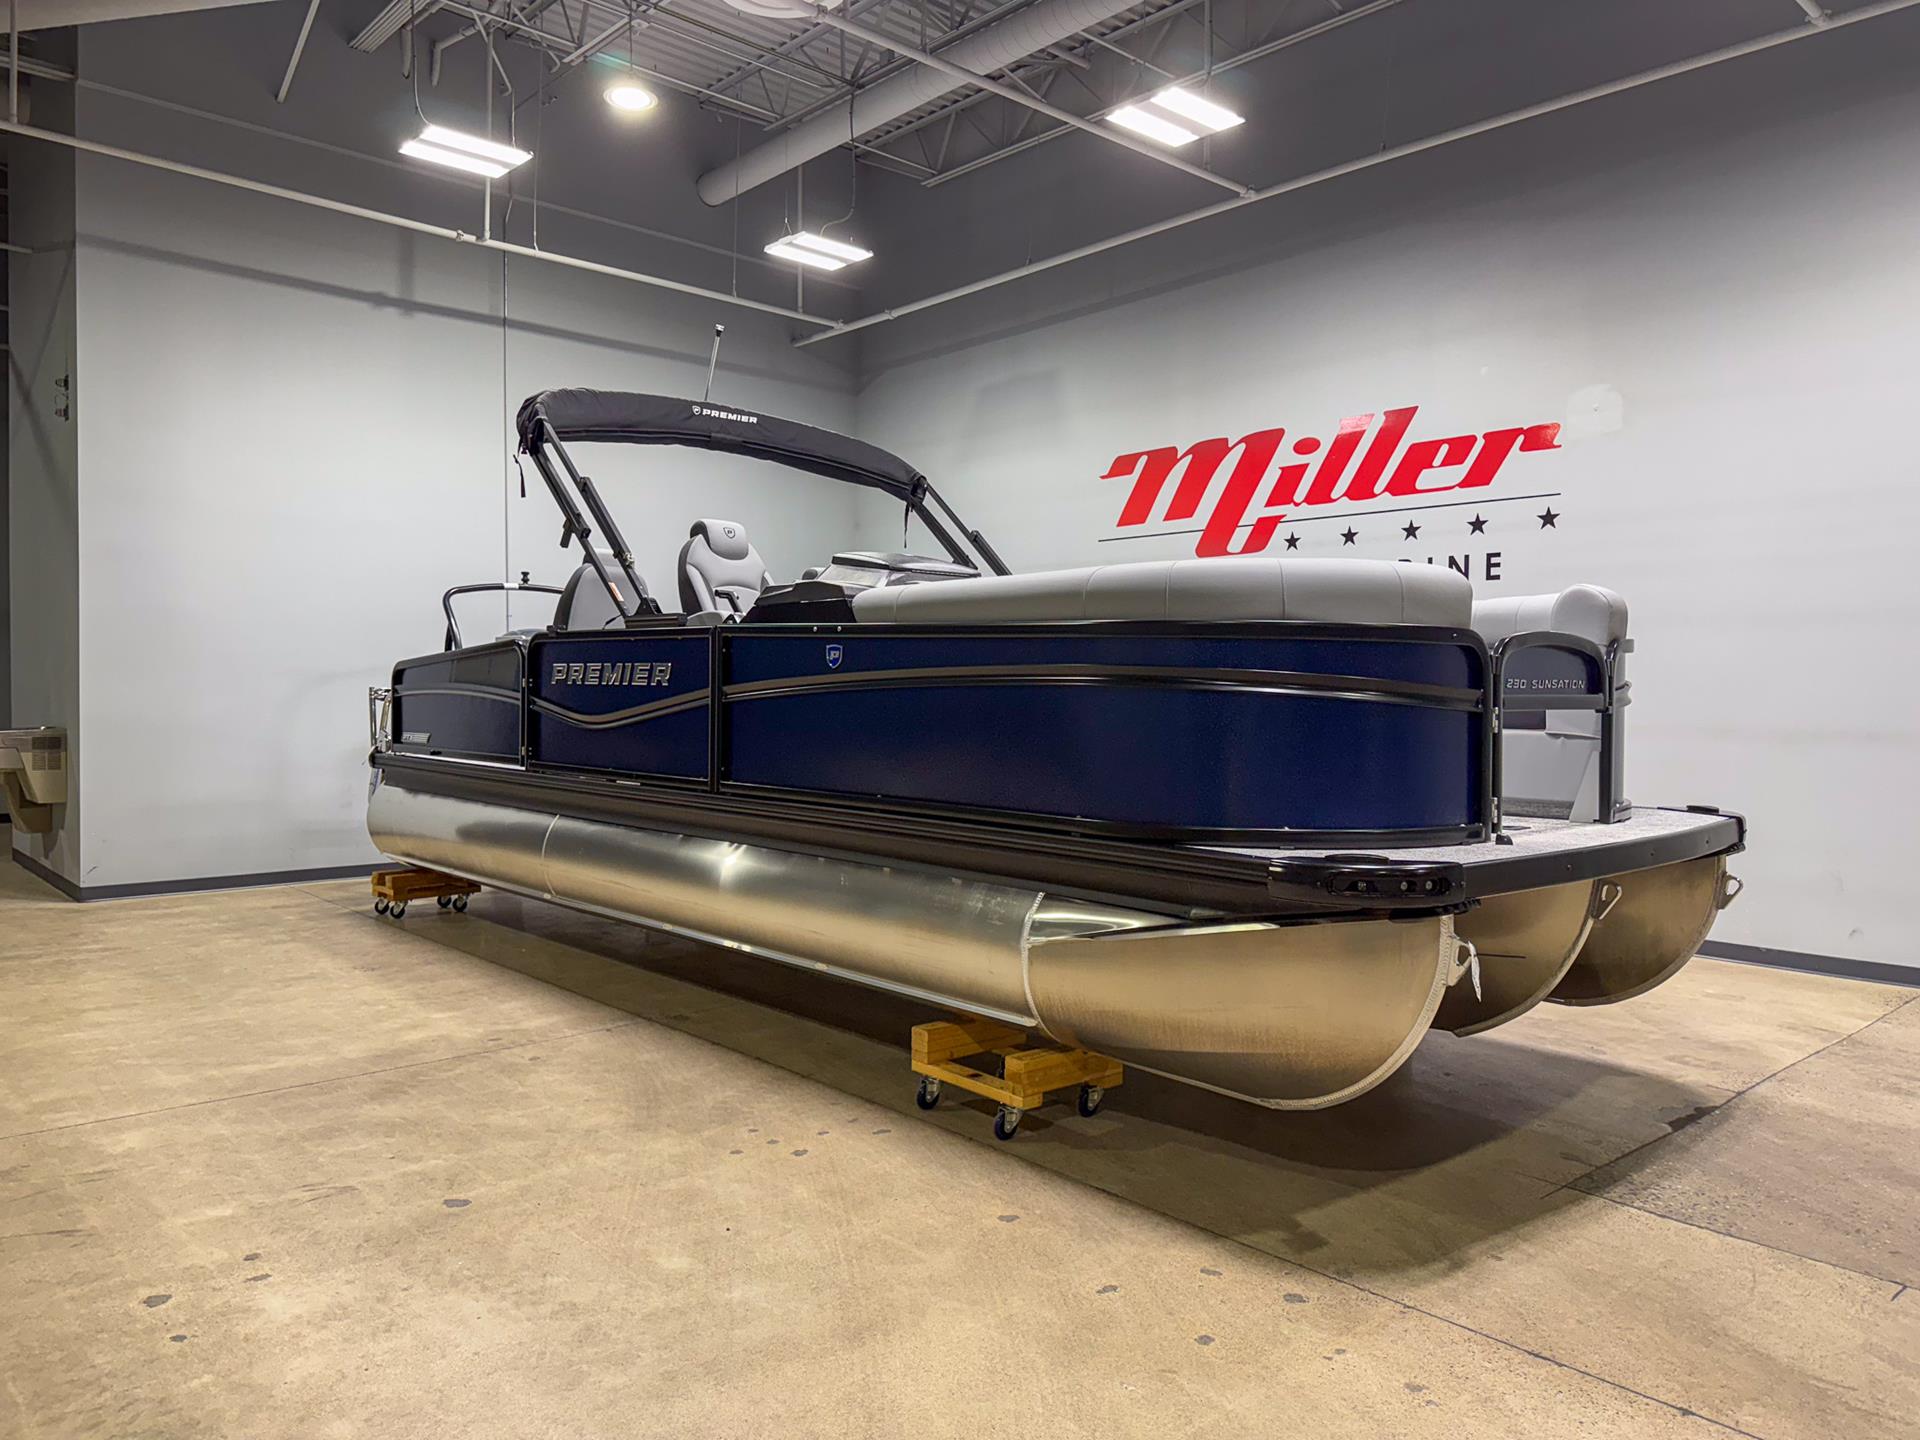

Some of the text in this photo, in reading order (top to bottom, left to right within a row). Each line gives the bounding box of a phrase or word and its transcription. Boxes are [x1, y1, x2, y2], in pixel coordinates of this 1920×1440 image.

[702, 408, 758, 424] PREMIER
[1100, 405, 1562, 558] Miller
[1398, 552, 1502, 581] NE
[551, 662, 672, 686] PREMIER
[1506, 678, 1585, 689] 230 SUNSATION
